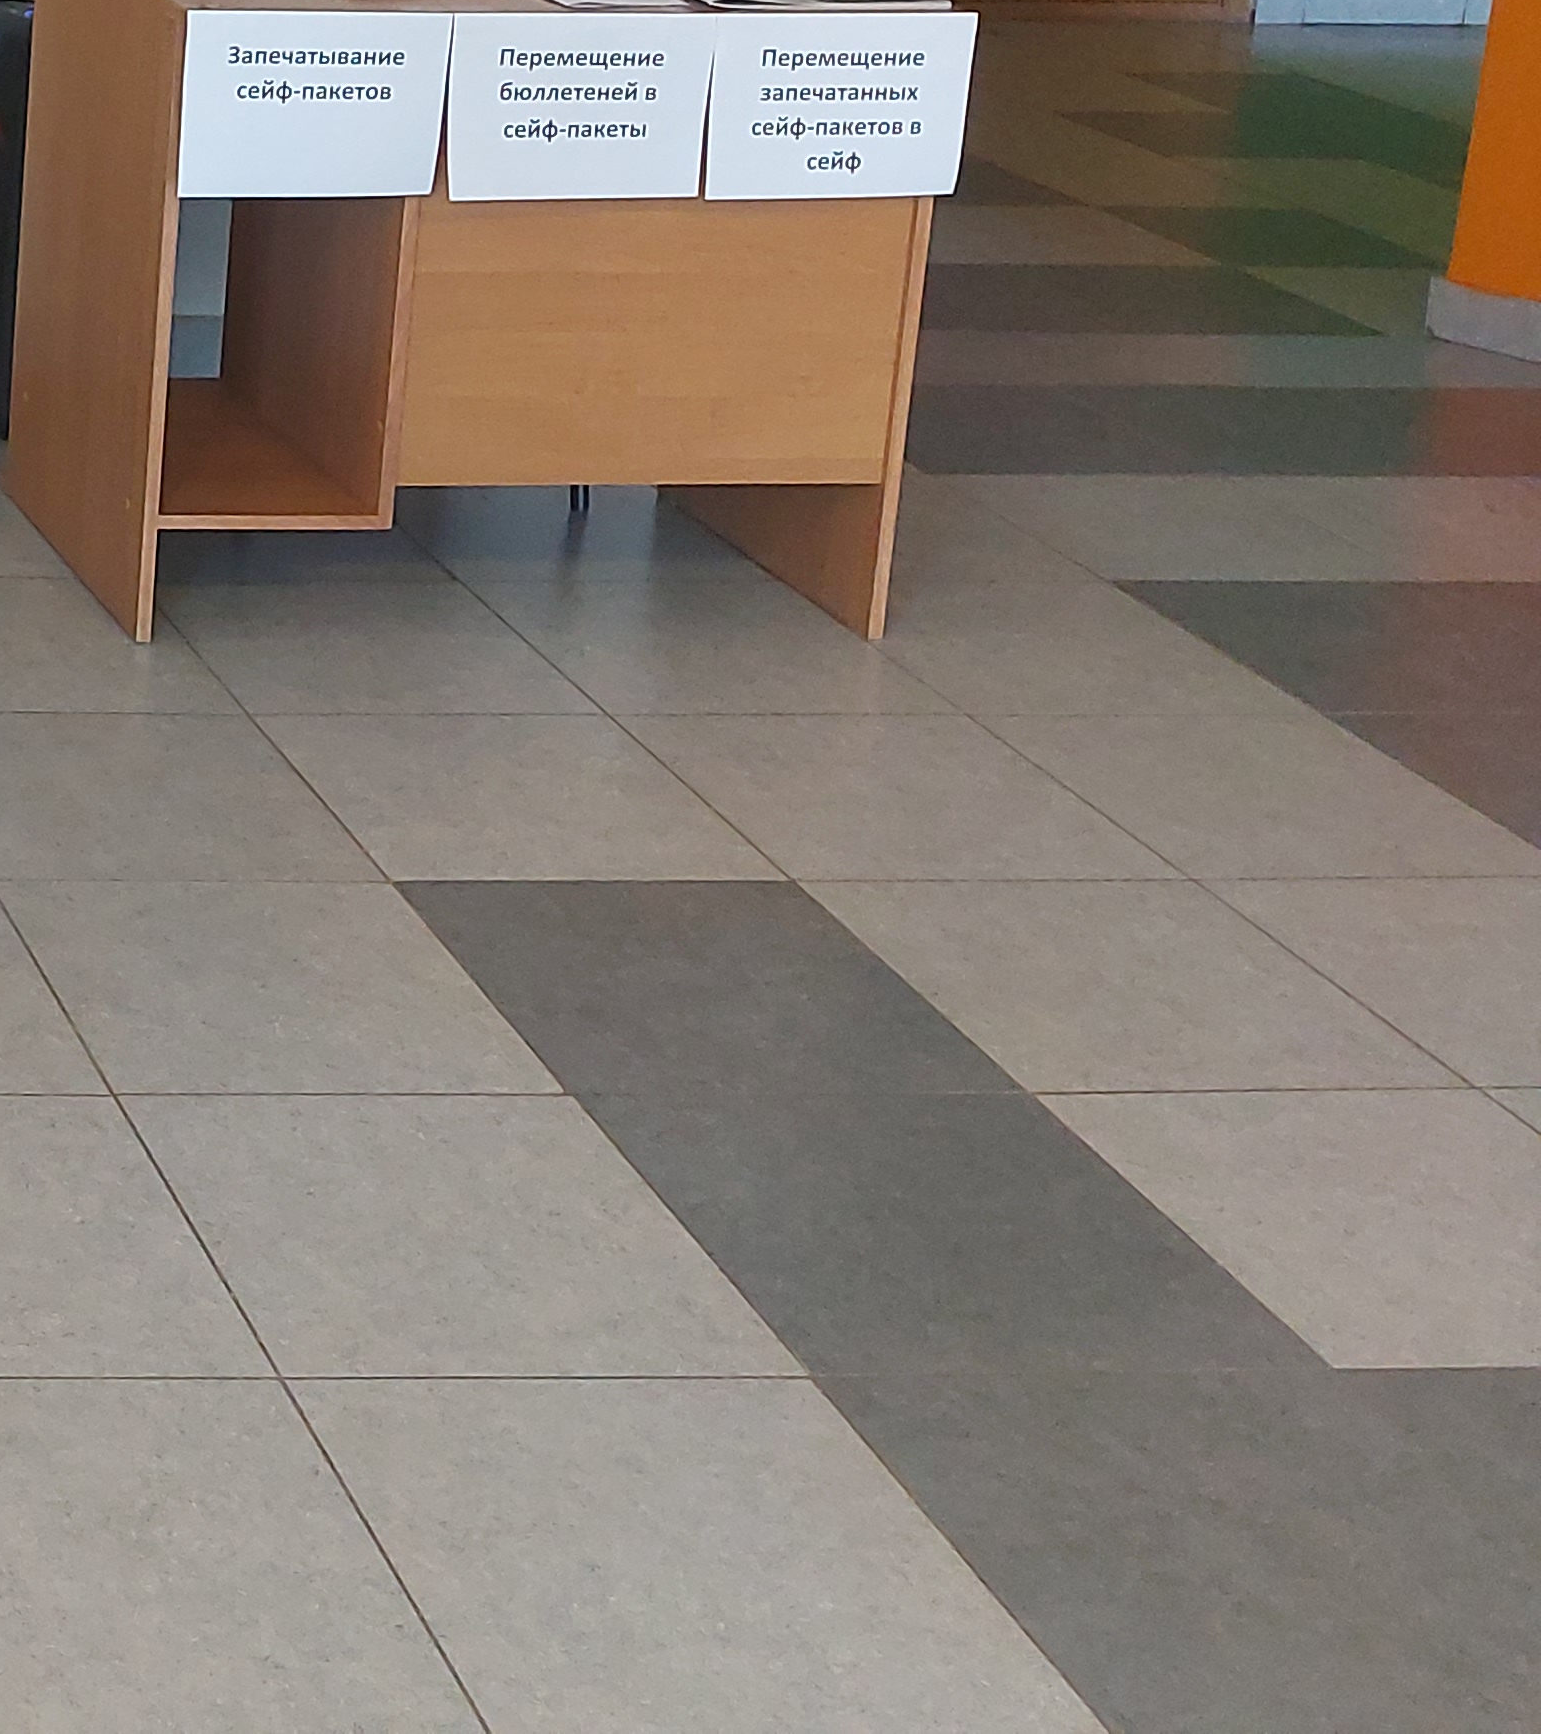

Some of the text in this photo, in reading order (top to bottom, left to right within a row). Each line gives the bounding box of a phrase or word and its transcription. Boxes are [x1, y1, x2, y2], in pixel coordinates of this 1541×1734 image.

[228, 46, 405, 66] Запечатывание
[500, 48, 665, 71] Перемещение
[762, 49, 925, 71] Перемещение
[237, 79, 392, 104] сейф-пакетов
[500, 81, 657, 101] бюллетеней в
[760, 86, 918, 102] запечатанных
[504, 118, 647, 142] сейф-пакеты
[752, 116, 921, 140] сейф-пакетов в
[807, 151, 862, 174] сейф
